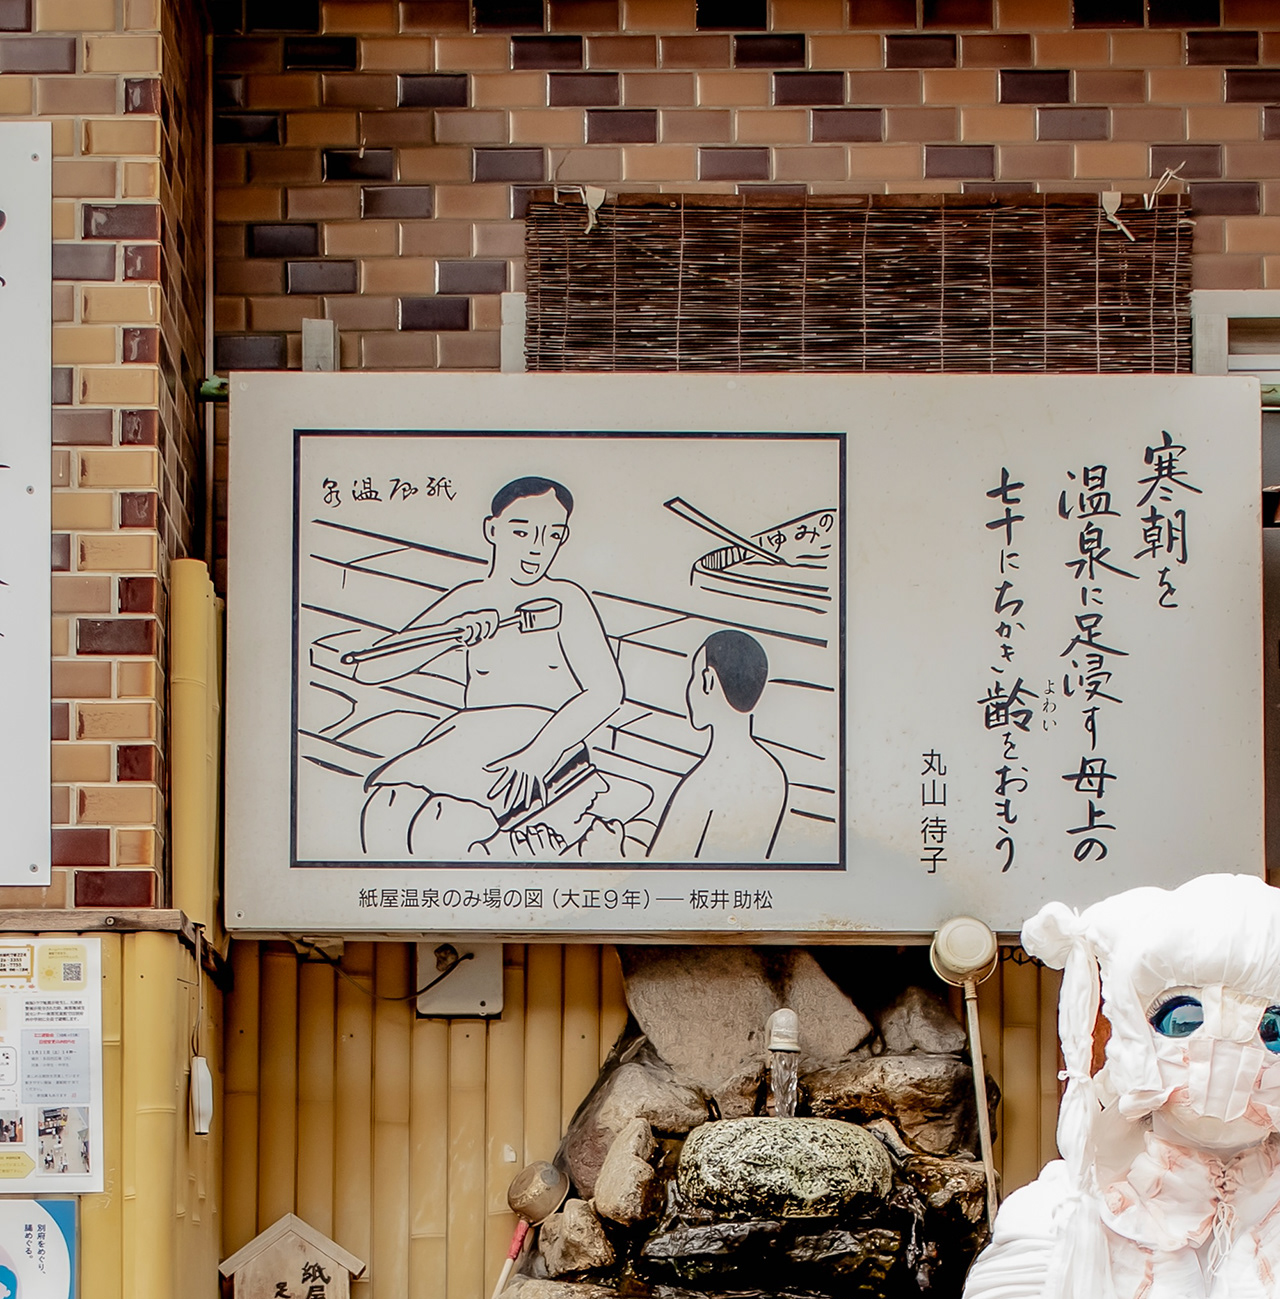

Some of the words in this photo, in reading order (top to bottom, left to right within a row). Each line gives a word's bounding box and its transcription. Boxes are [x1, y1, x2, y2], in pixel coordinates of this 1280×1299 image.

[1133, 430, 1203, 608] 寒朝を
[977, 467, 1040, 873] 七十にちかき齢をおもう
[1041, 679, 1058, 732] よわい
[1058, 465, 1140, 862] 温泉に足浸す母上の
